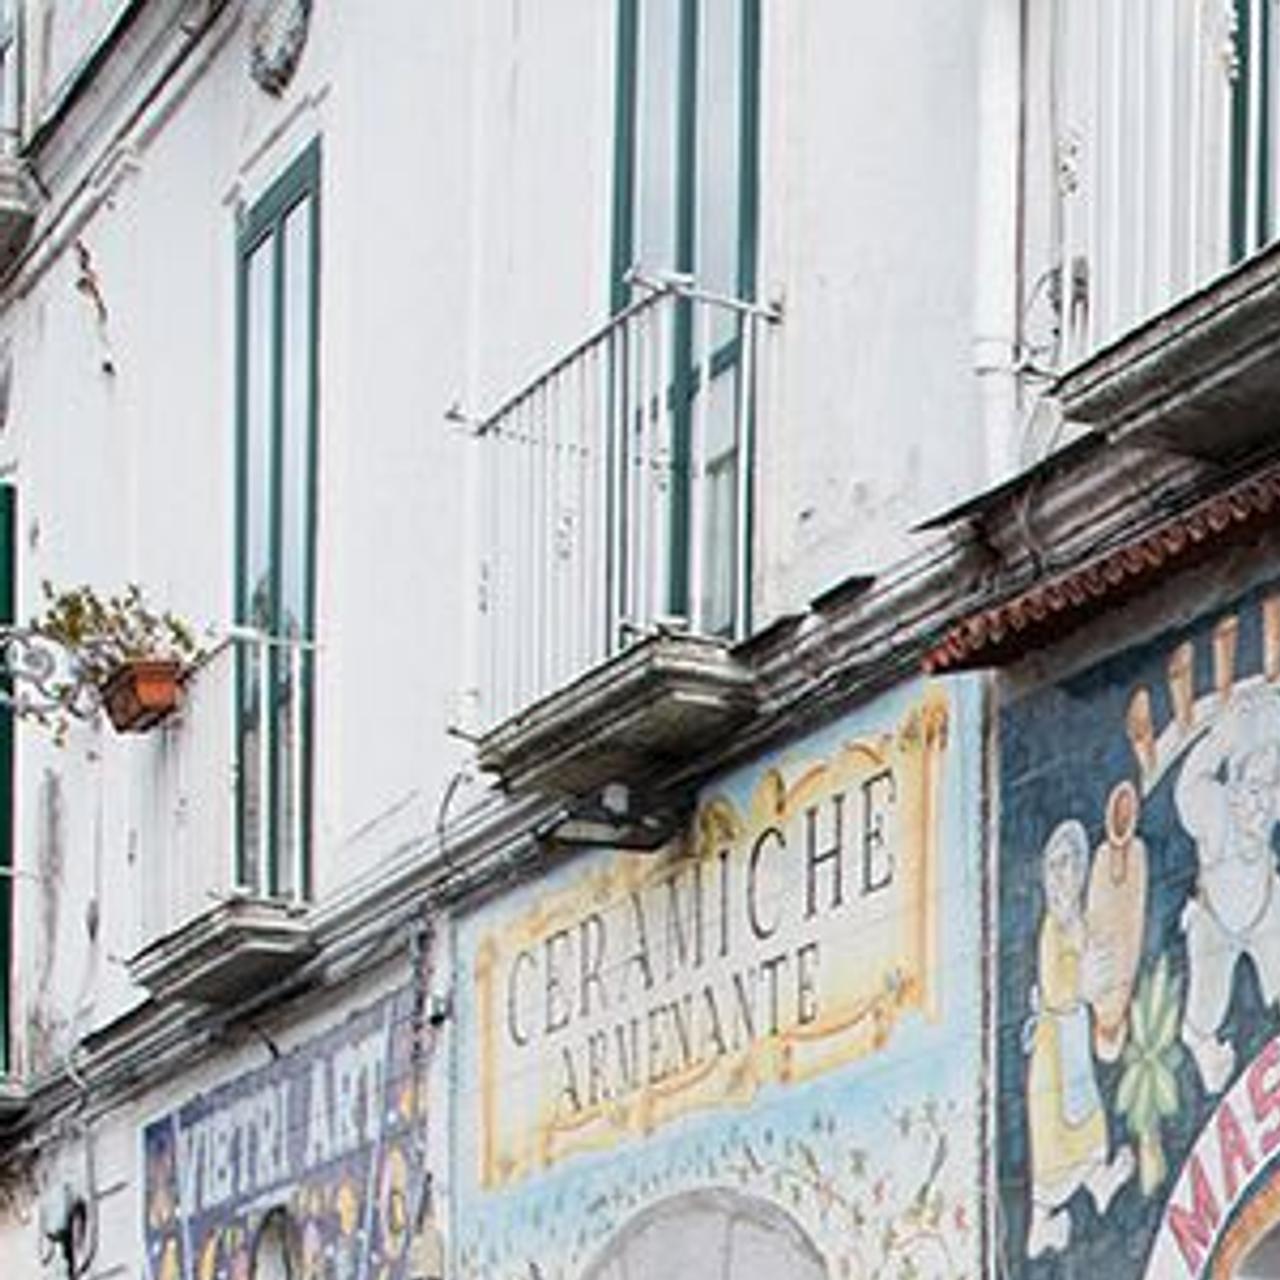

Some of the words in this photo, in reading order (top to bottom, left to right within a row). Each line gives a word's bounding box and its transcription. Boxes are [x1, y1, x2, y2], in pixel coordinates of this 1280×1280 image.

[507, 768, 896, 1047] CERAMICHE
[178, 1080, 292, 1216] VIETRI
[305, 1032, 386, 1168] ART
